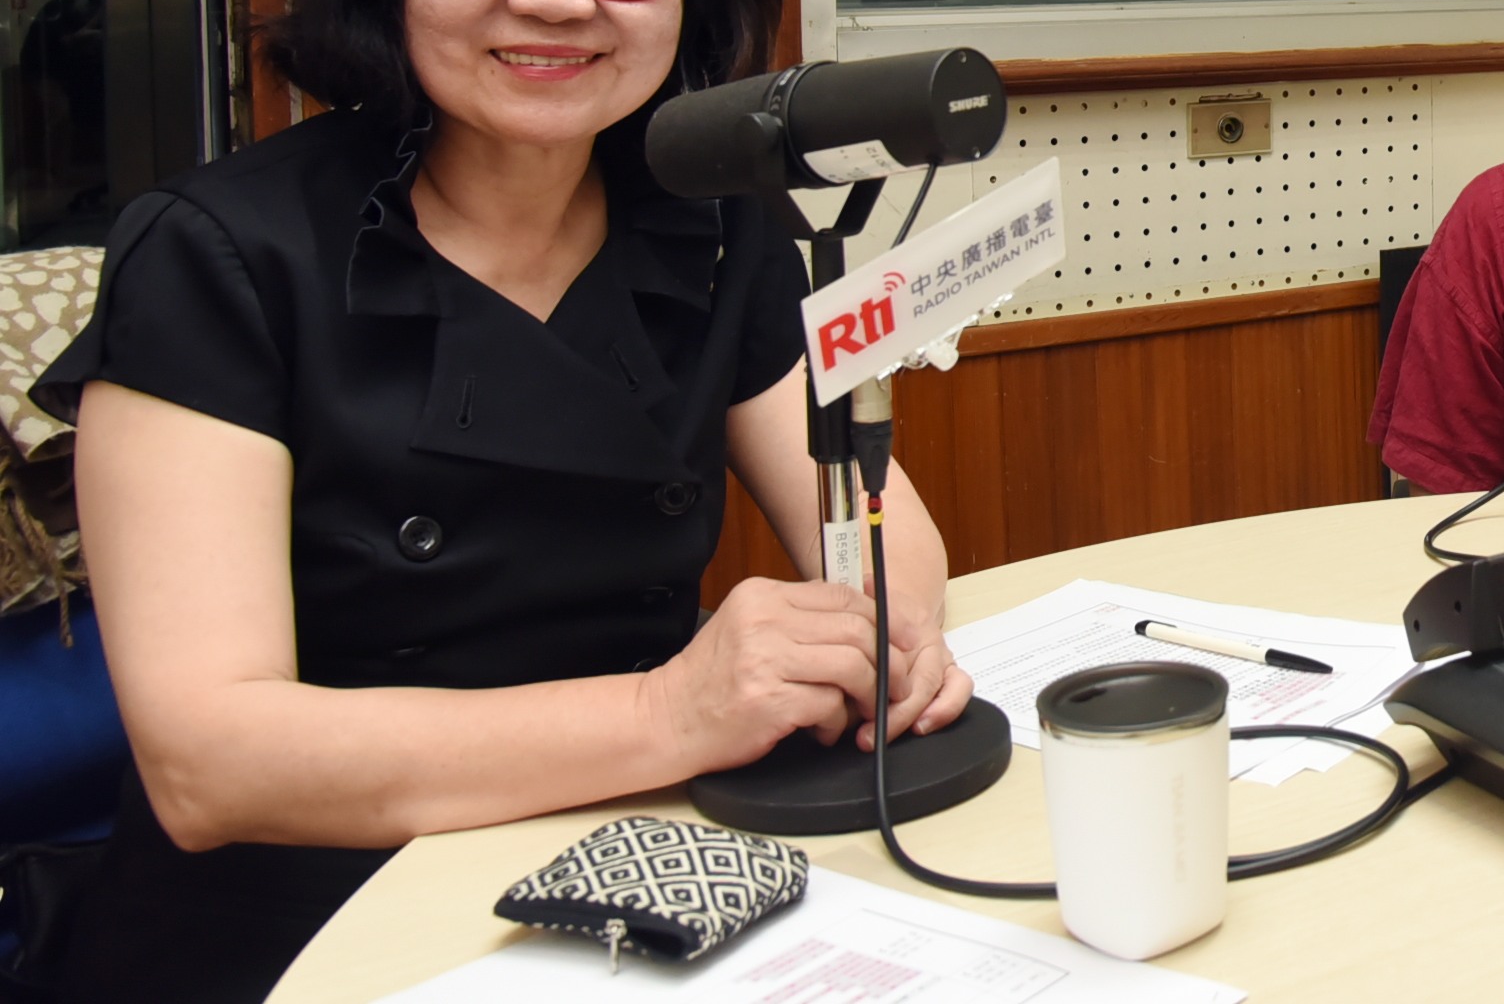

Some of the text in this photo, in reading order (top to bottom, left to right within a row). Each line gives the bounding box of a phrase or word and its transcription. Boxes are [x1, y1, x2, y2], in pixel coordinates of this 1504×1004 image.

[949, 94, 989, 113] SHURE
[910, 198, 1055, 297] 中央廣播電臺
[913, 226, 1056, 319] RADIO TAIWAN INTL
[817, 292, 896, 373] Rti
